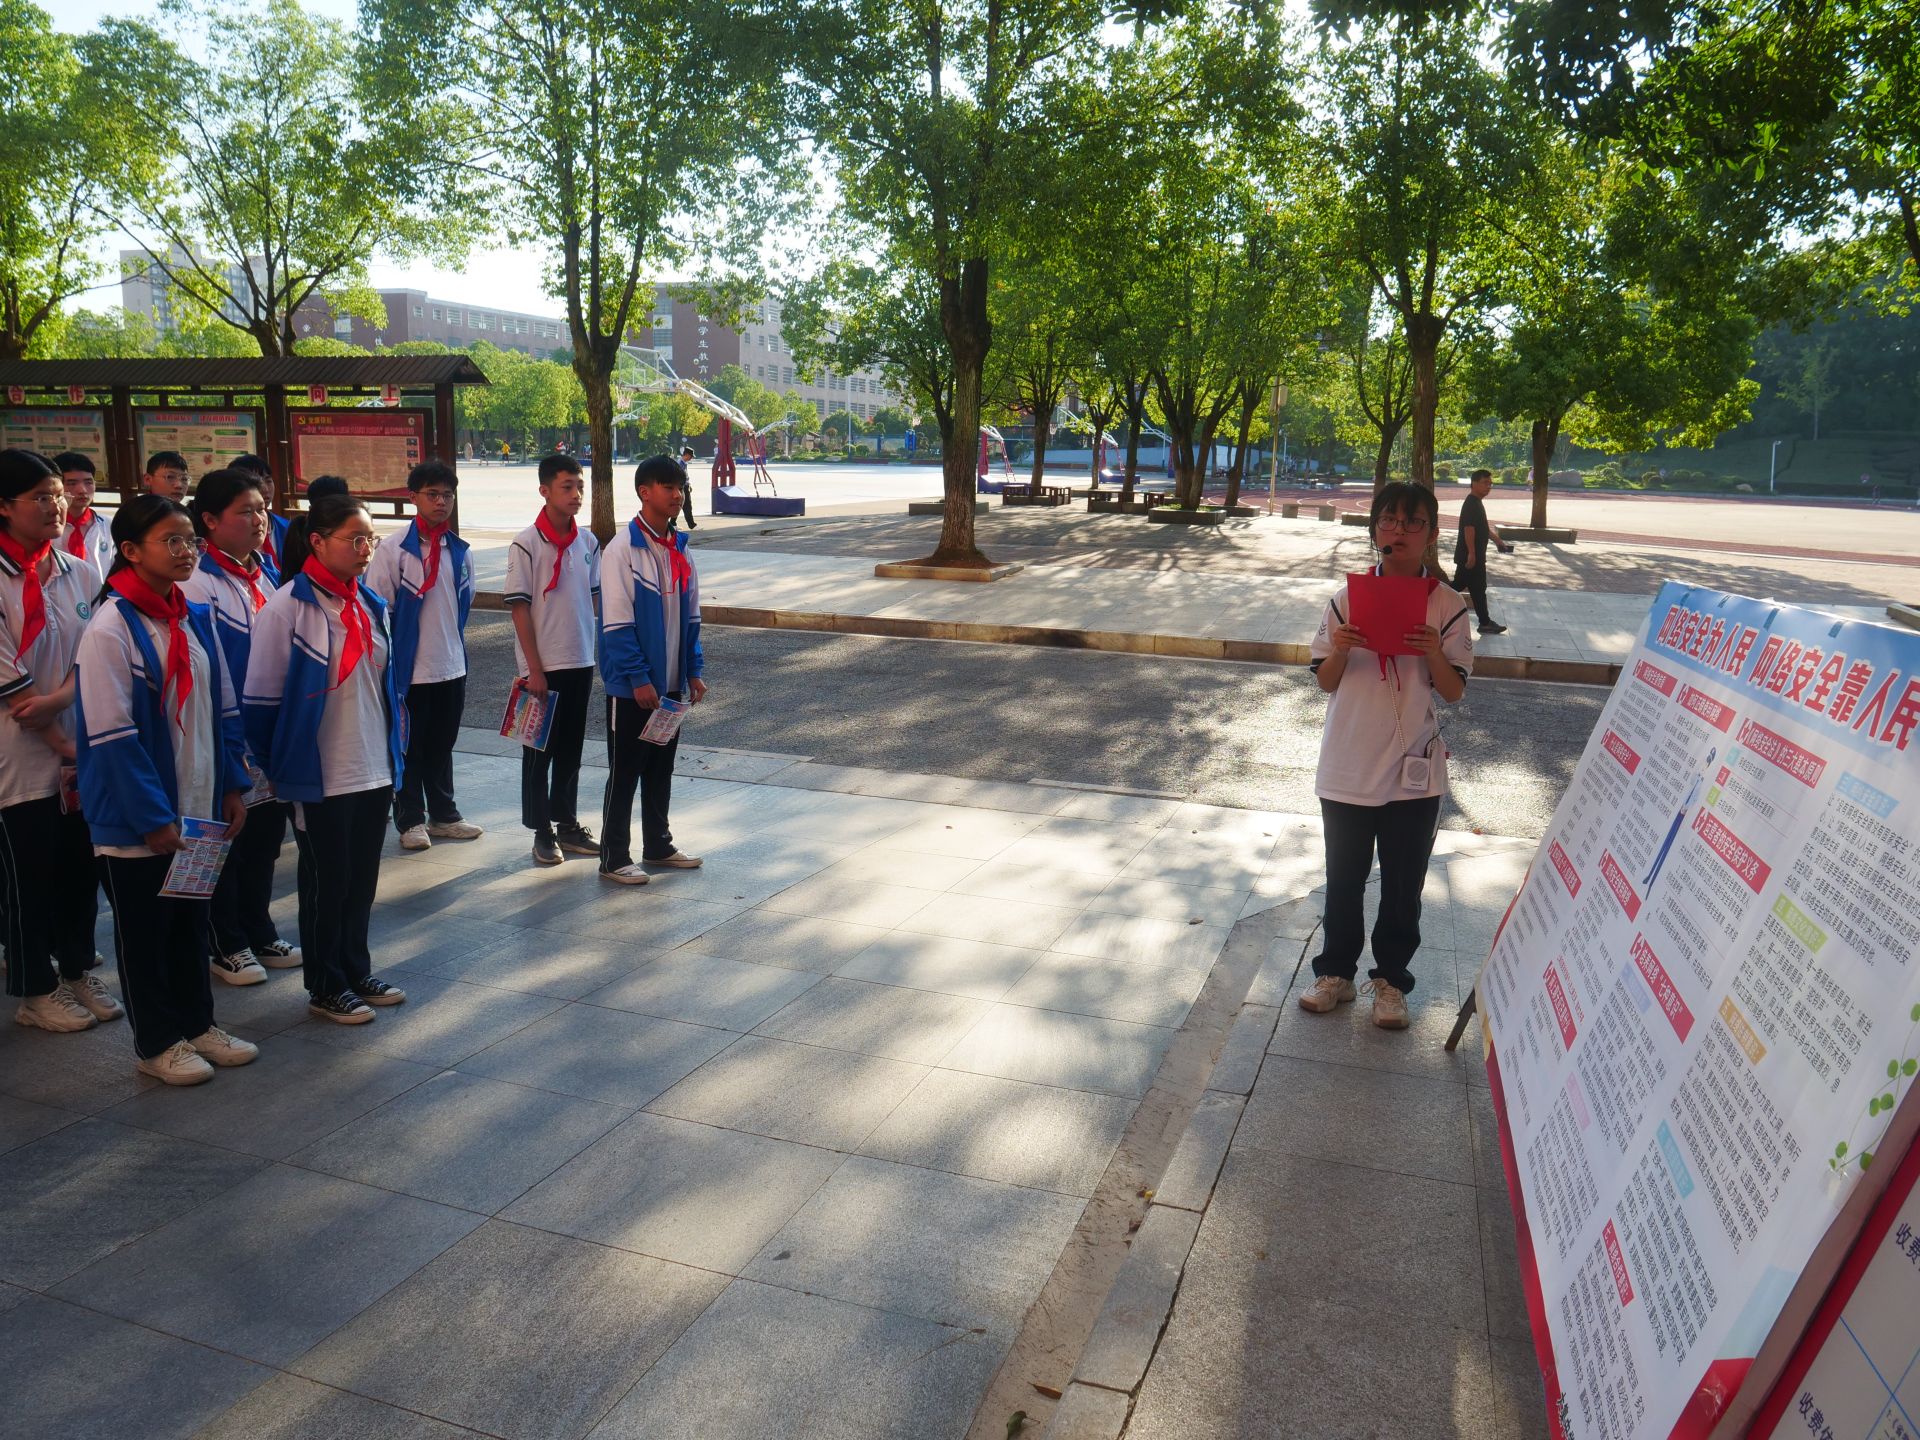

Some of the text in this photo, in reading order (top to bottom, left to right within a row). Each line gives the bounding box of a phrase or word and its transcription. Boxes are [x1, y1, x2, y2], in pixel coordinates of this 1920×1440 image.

[9, 385, 84, 402] 合 作
[311, 384, 399, 402] 向 上
[1657, 606, 1758, 677] 网络安全为人民
[1749, 636, 1920, 751] 网络安全靠人民
[1745, 727, 1823, 785] 《网络安全法》的三大基本原则
[1702, 818, 1760, 882] 运营者的安全保护义务
[1638, 946, 1683, 1024] 培养网络“七种意识”
